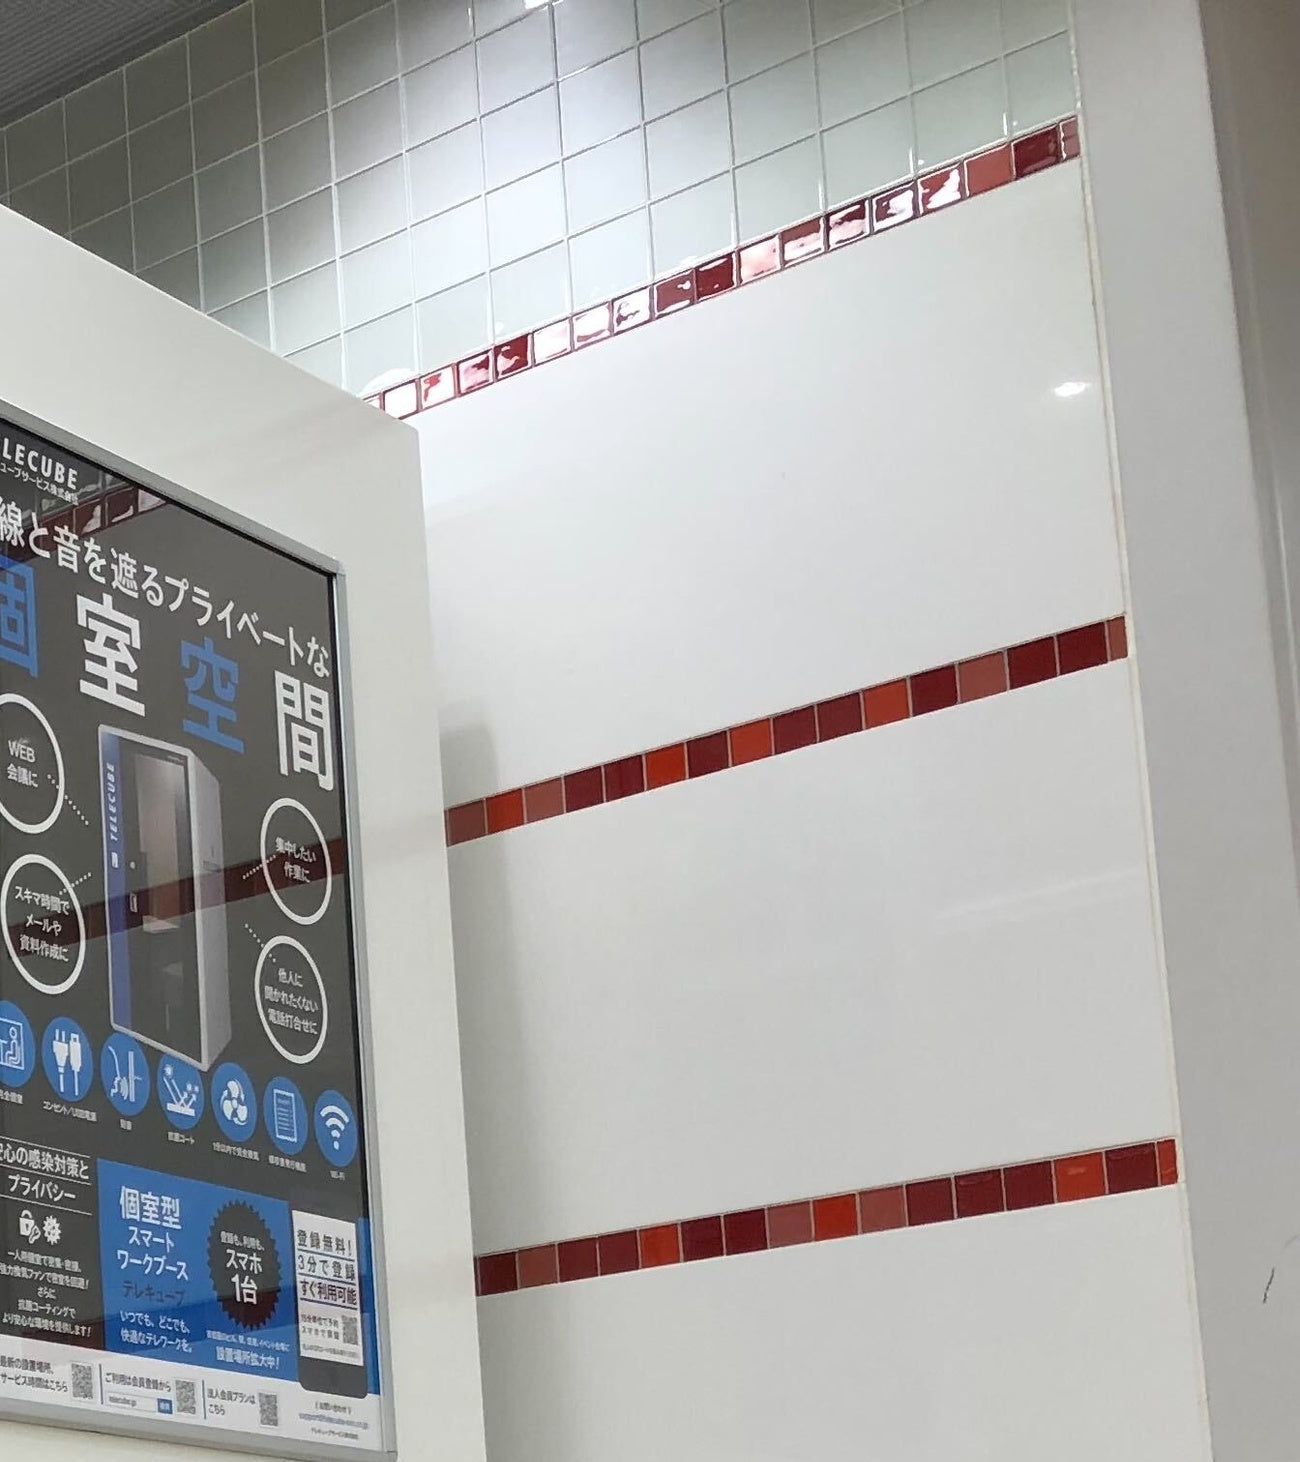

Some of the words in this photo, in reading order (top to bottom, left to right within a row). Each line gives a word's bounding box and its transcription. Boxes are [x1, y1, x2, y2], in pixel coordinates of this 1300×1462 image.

[8, 740, 36, 763] WEB
[7, 763, 39, 788] 会議に
[14, 886, 70, 916] スキマ時間で
[25, 913, 62, 936] メールや
[8, 1174, 77, 1202] プライバシー
[119, 1185, 183, 1230] 個室型
[128, 1226, 175, 1254] スマート
[117, 1249, 189, 1281] ワークブース
[226, 1248, 263, 1275] スマホ
[231, 1273, 258, 1306] 1台
[299, 1279, 358, 1306] すぐ利用可能
